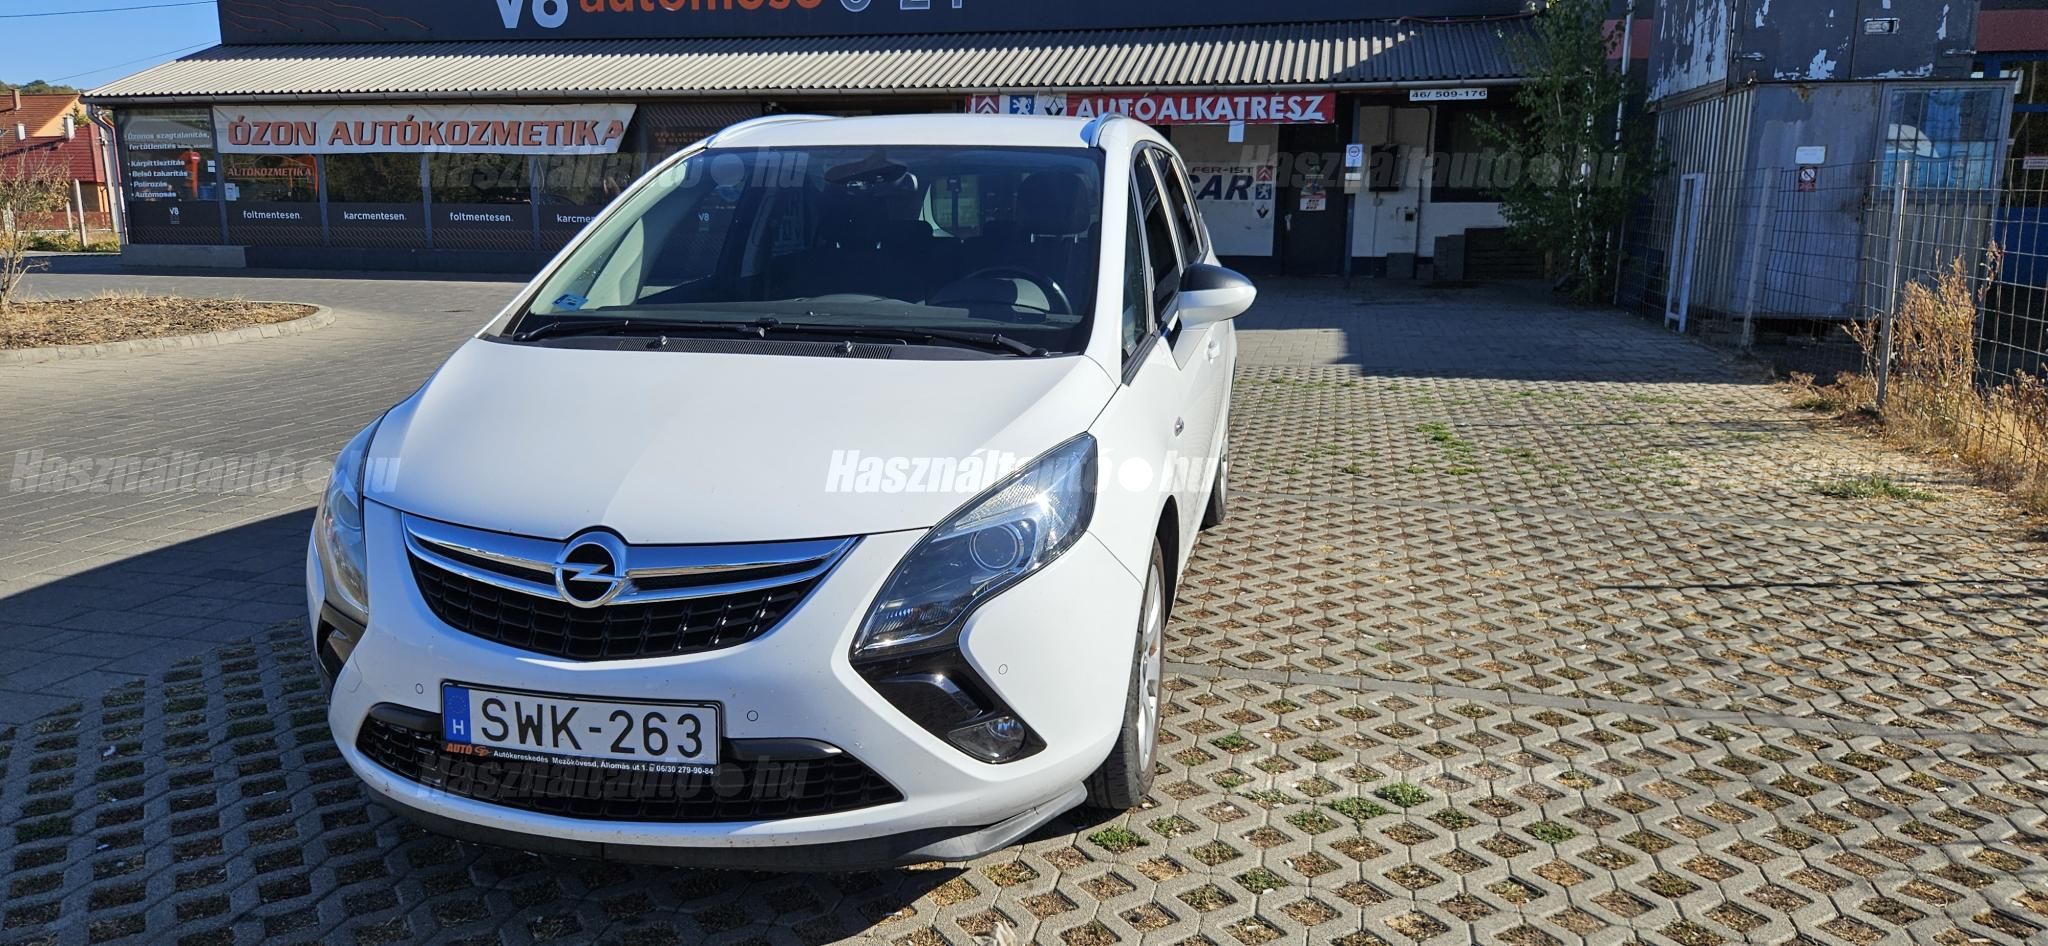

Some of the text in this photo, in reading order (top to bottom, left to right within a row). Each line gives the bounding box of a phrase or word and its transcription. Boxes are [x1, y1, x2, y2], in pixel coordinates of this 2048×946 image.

[1411, 90, 1487, 99] 46/ 509-176
[1076, 92, 1326, 121] AUTÓALKATRÉSZ
[227, 113, 625, 147] ÓZON AUTÓKOZMETIKA
[169, 207, 180, 215] V8
[242, 210, 303, 220] foltmentesen.
[343, 211, 407, 221] karcmentesen.
[449, 212, 514, 222] foltmentesen.
[698, 212, 710, 221] V8
[452, 718, 465, 736] H
[481, 697, 703, 759] SWK-263
[493, 750, 549, 763] Autókereskedés
[656, 765, 676, 773] 06/30
